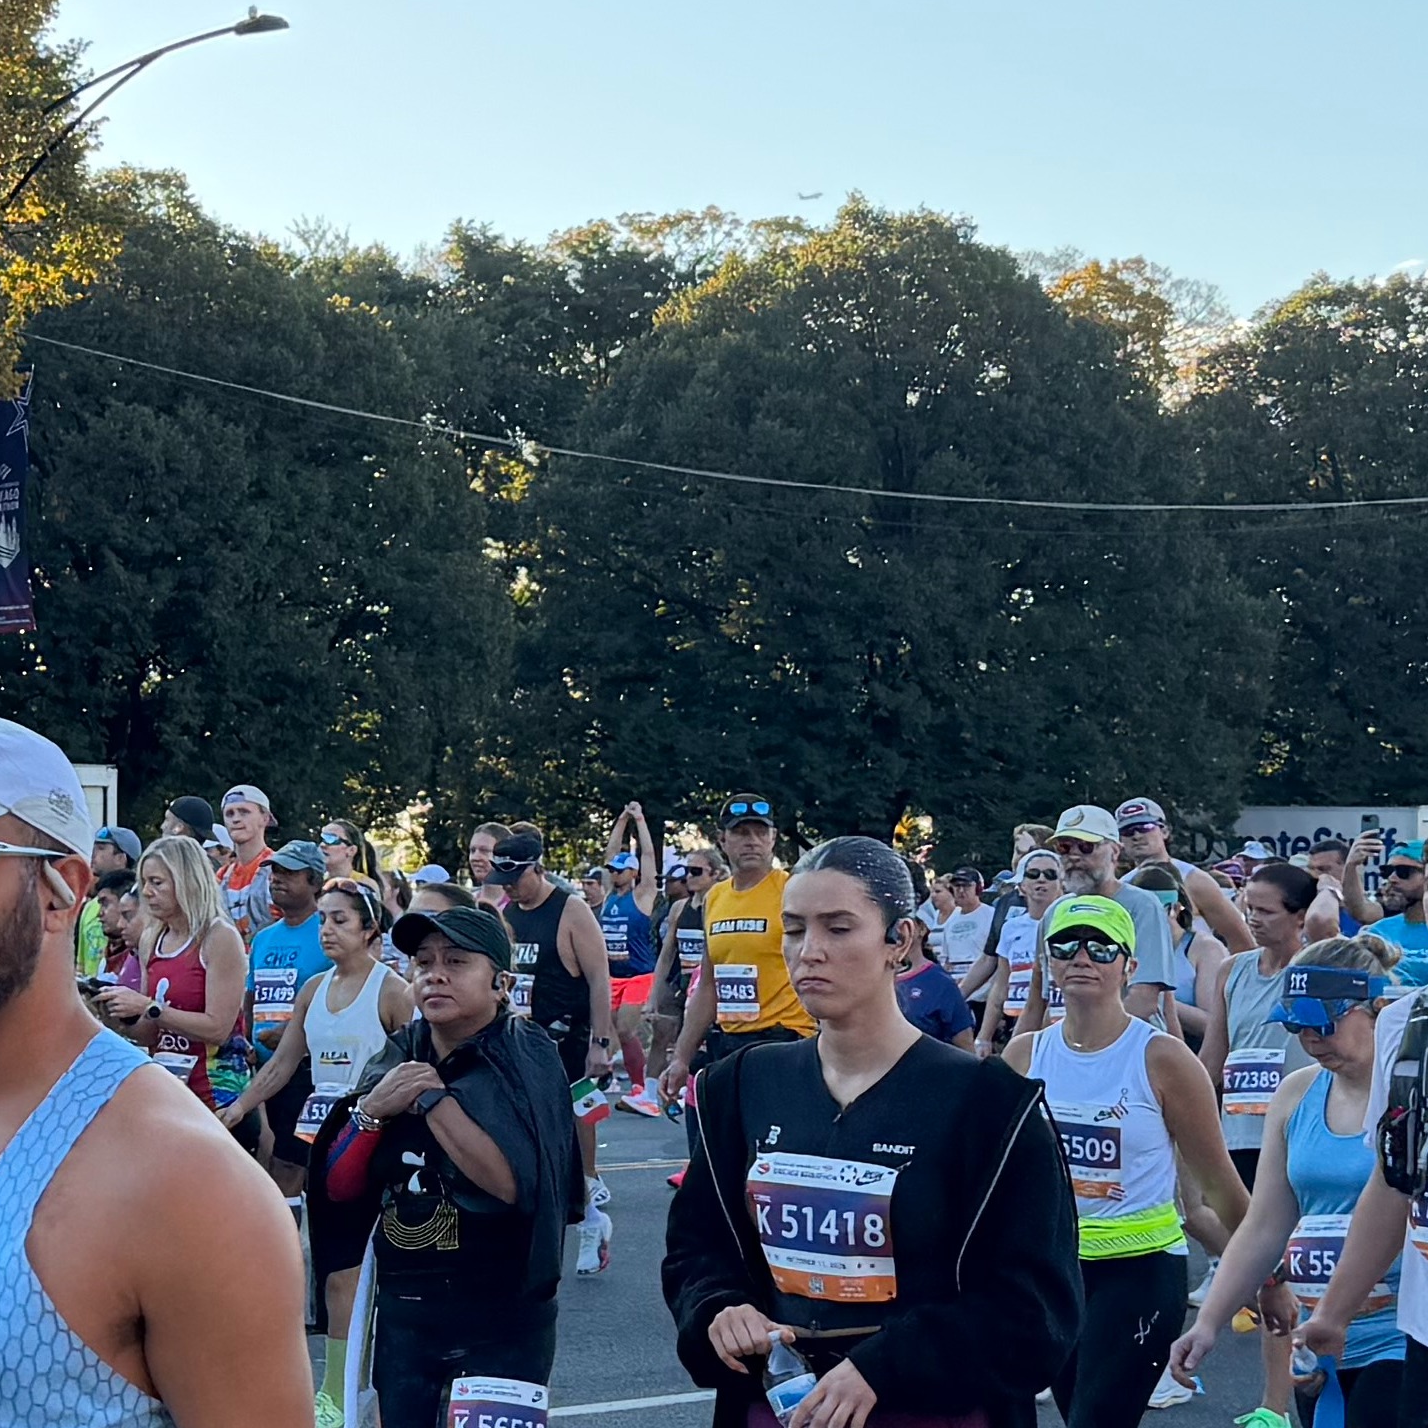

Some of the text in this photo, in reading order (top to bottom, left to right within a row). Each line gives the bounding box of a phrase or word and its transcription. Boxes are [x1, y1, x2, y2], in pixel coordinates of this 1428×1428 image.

[1234, 1070, 1281, 1090] 72389
[872, 1143, 916, 1155] BANDIT
[756, 1203, 886, 1248] K 51418
[1290, 1253, 1303, 1277] K
